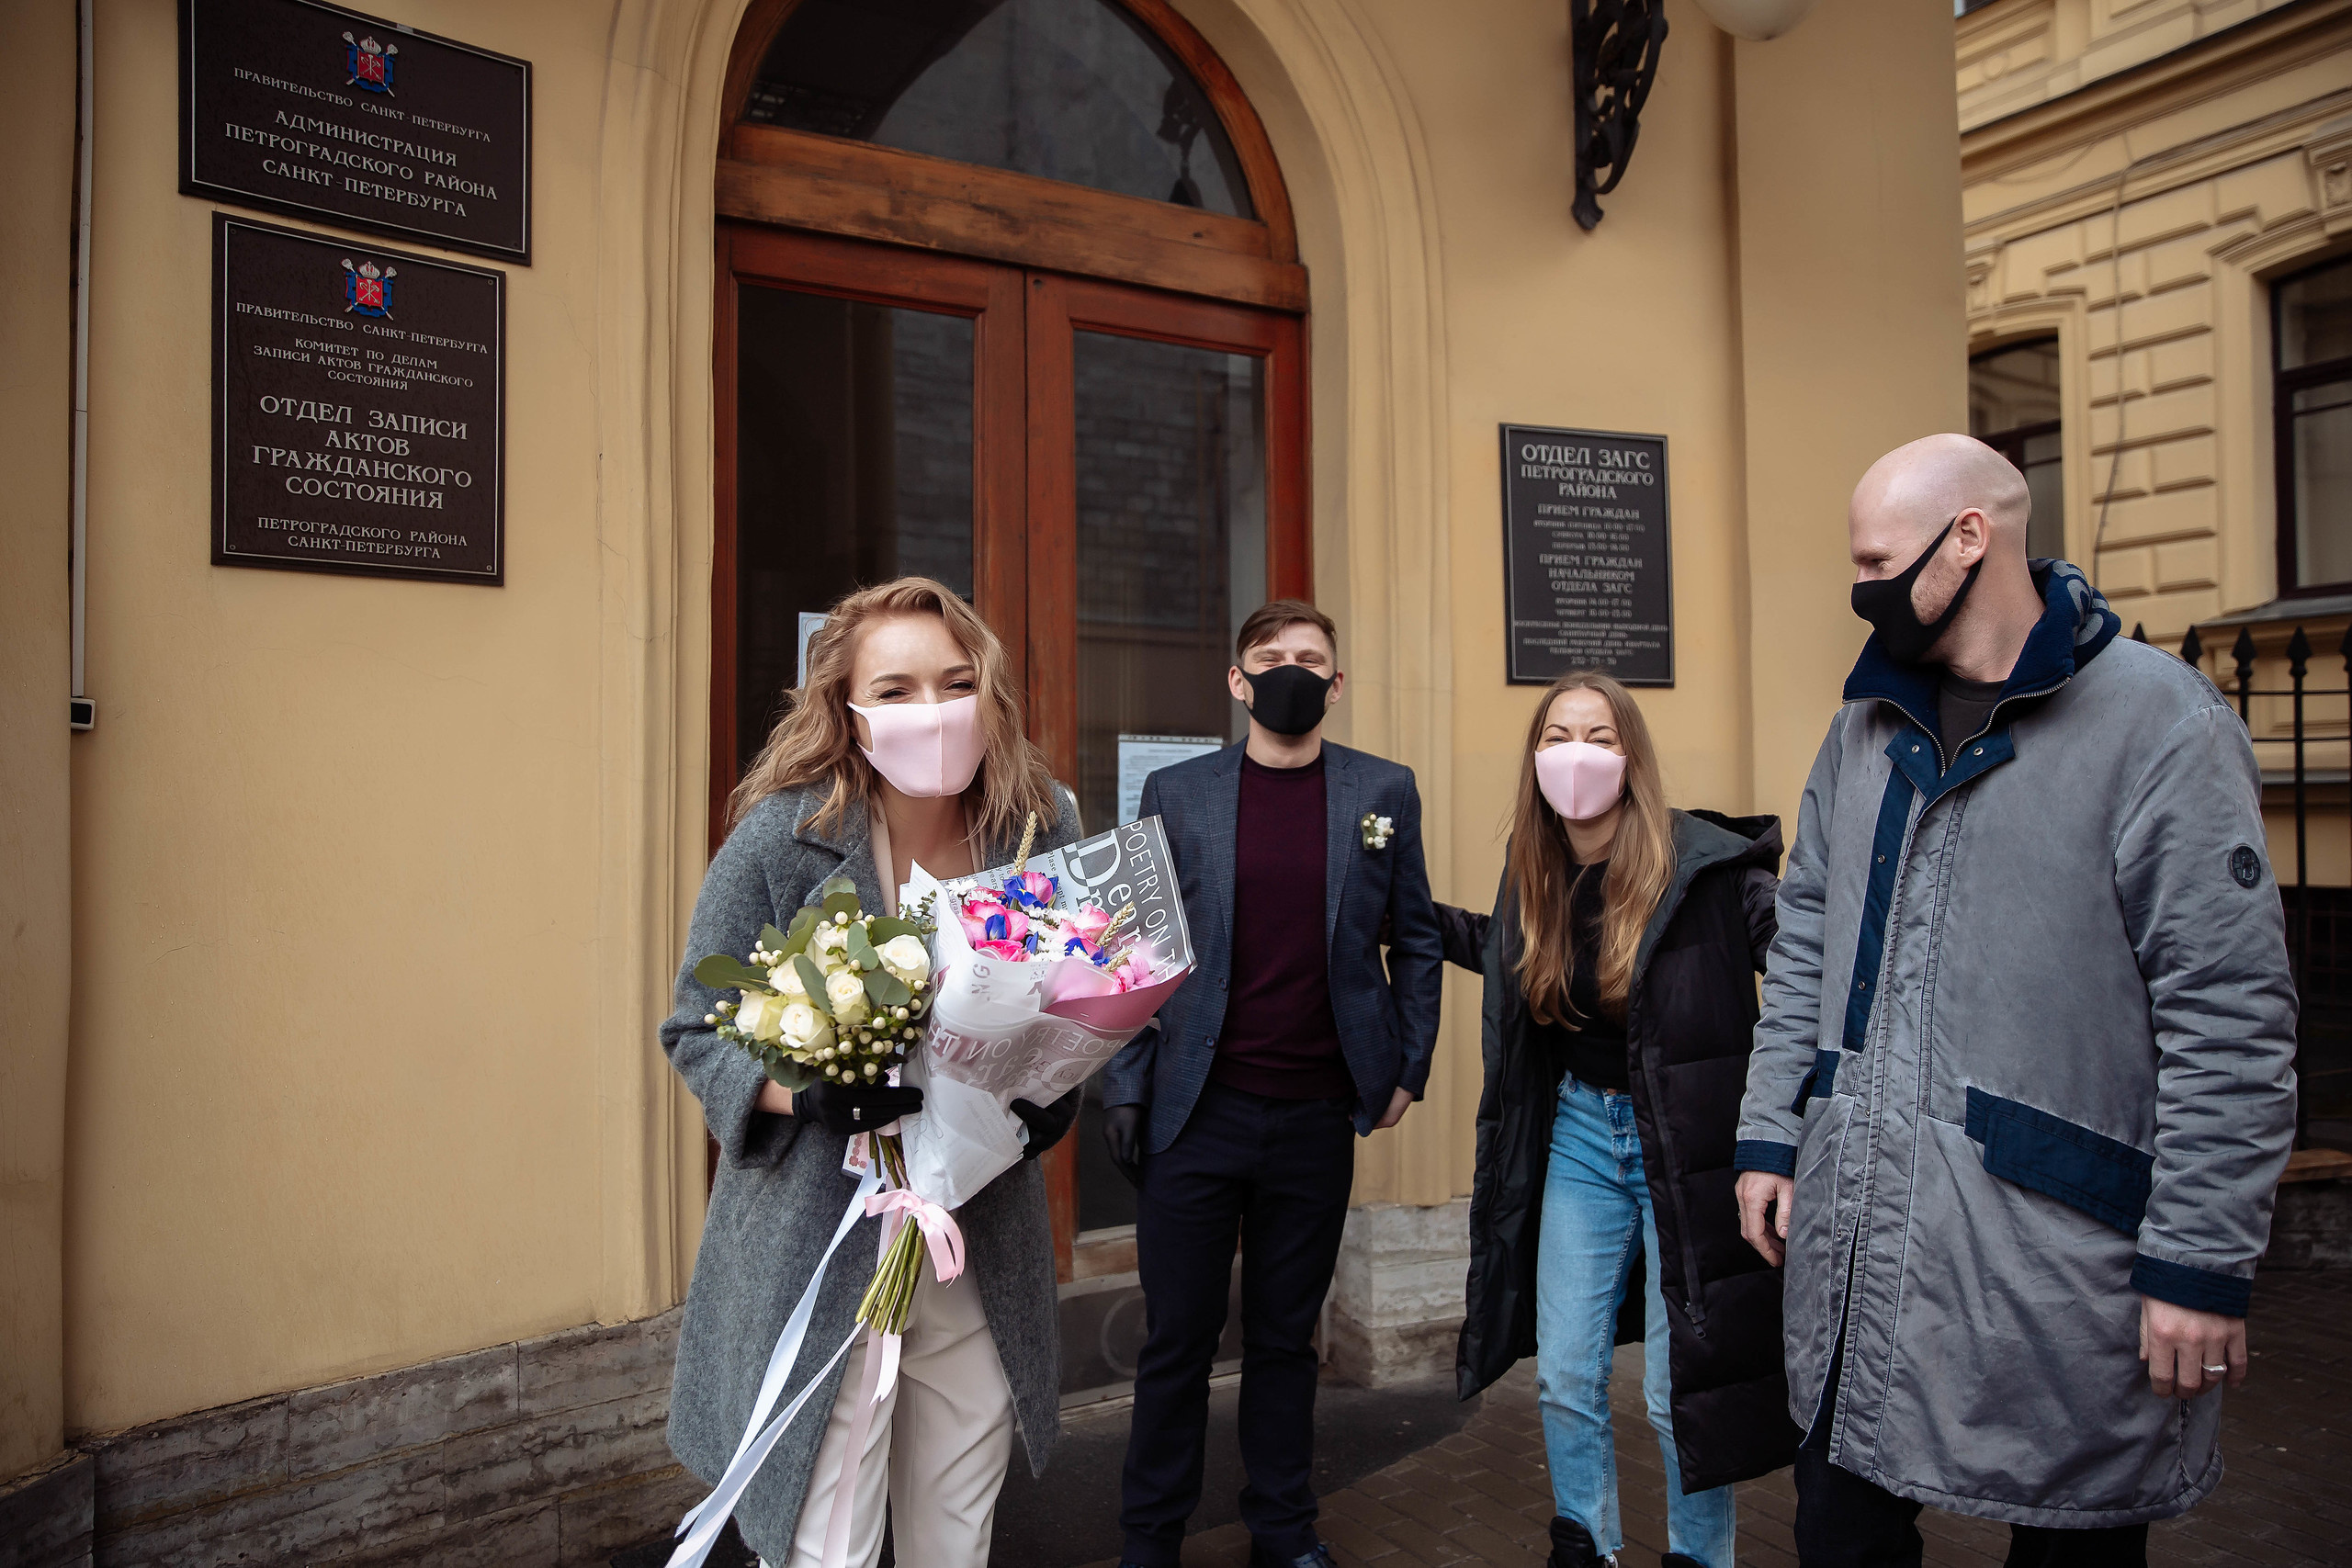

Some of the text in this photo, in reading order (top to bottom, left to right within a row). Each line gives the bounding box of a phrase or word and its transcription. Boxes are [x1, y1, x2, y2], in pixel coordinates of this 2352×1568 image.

[233, 67, 354, 107] ПРАВИТЕЛЬСТВО
[275, 110, 458, 167] АДМИНИСТРАЦИЯ
[225, 122, 499, 201] ПЕТРОГРАДСКОГО РАЙОНА
[235, 301, 489, 354] ПРАВИТЕЛЬСТВО САНКТ-ПЕТЕРБУРГА
[253, 344, 474, 389] ЗАПИСИ АКТОВ ГРАЖДАНСКОГО
[295, 337, 438, 369] КОМИТЕТ ПО ДЕЛАМ
[327, 370, 409, 391] СОСТОЯНИЯ
[259, 395, 469, 441] ОТДЕЛ ЗАПИСИ
[324, 429, 411, 457] АКТОВ
[1521, 444, 1651, 470] ОТДЕЛ ЗАГС
[251, 445, 472, 488] ГРАЖДАНСКОГО
[1521, 464, 1655, 487] ПЕТРОГРАДСКОГО
[285, 476, 445, 510] СОСТОЯНИЯ
[1558, 481, 1618, 501] РАЙОНА
[1537, 503, 1640, 521] ПРИЕМ ГРАЖДАН
[257, 516, 468, 547] ПЕТРОГРАДСКОГО РАЙОНА
[288, 536, 441, 559] САНКТ-ПЕТЕРБУРГА
[1539, 553, 1643, 570] ПРИЕМ ГРАЖДАН
[1548, 568, 1635, 582] НАЧАЛЬНИКОМ
[1551, 581, 1633, 594] ОТДЕЛА ЗАГС
[1121, 820, 1163, 905] POETRY
[1145, 908, 1172, 949] ON
